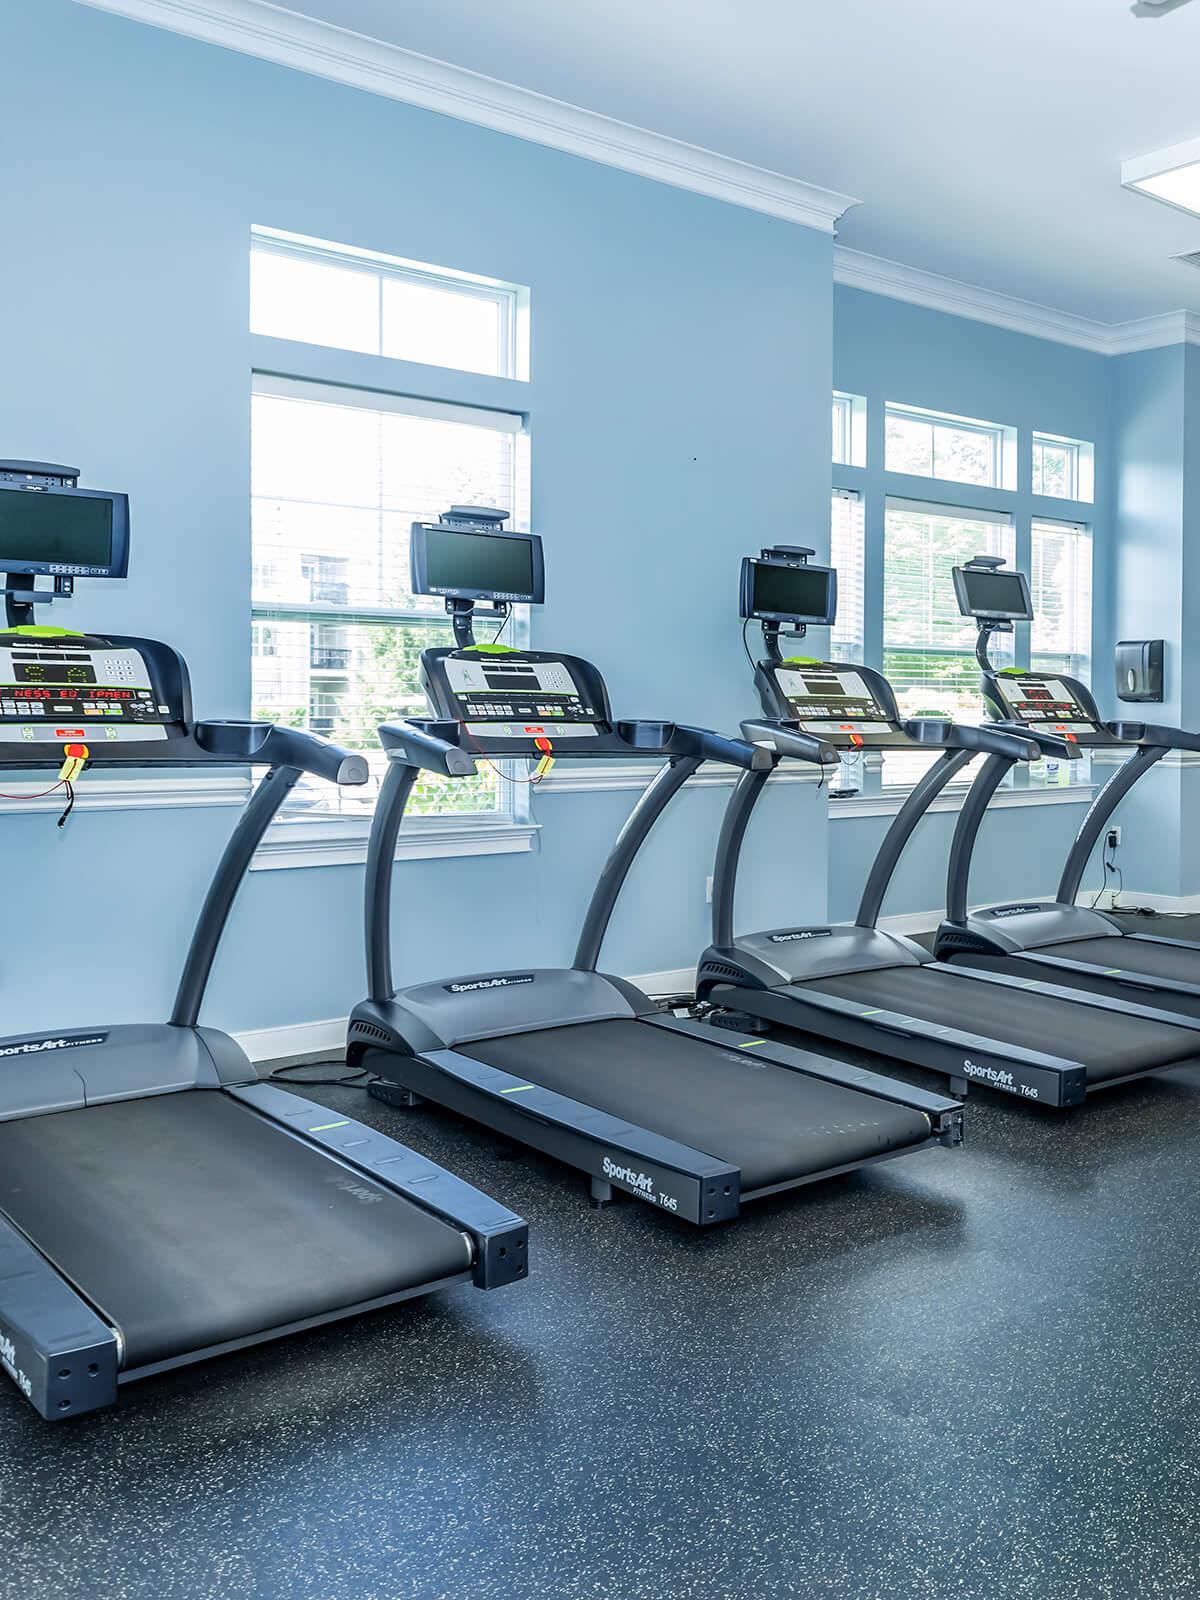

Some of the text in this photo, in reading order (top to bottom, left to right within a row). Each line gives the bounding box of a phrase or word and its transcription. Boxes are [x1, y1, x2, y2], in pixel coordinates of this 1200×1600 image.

[451, 979, 509, 992] SportsArt
[963, 1060, 1014, 1085] SportsArt
[993, 1082, 1039, 1098] FITNESS T645
[602, 1157, 653, 1192] SportsArt
[632, 1186, 678, 1211] FITNESS T645
